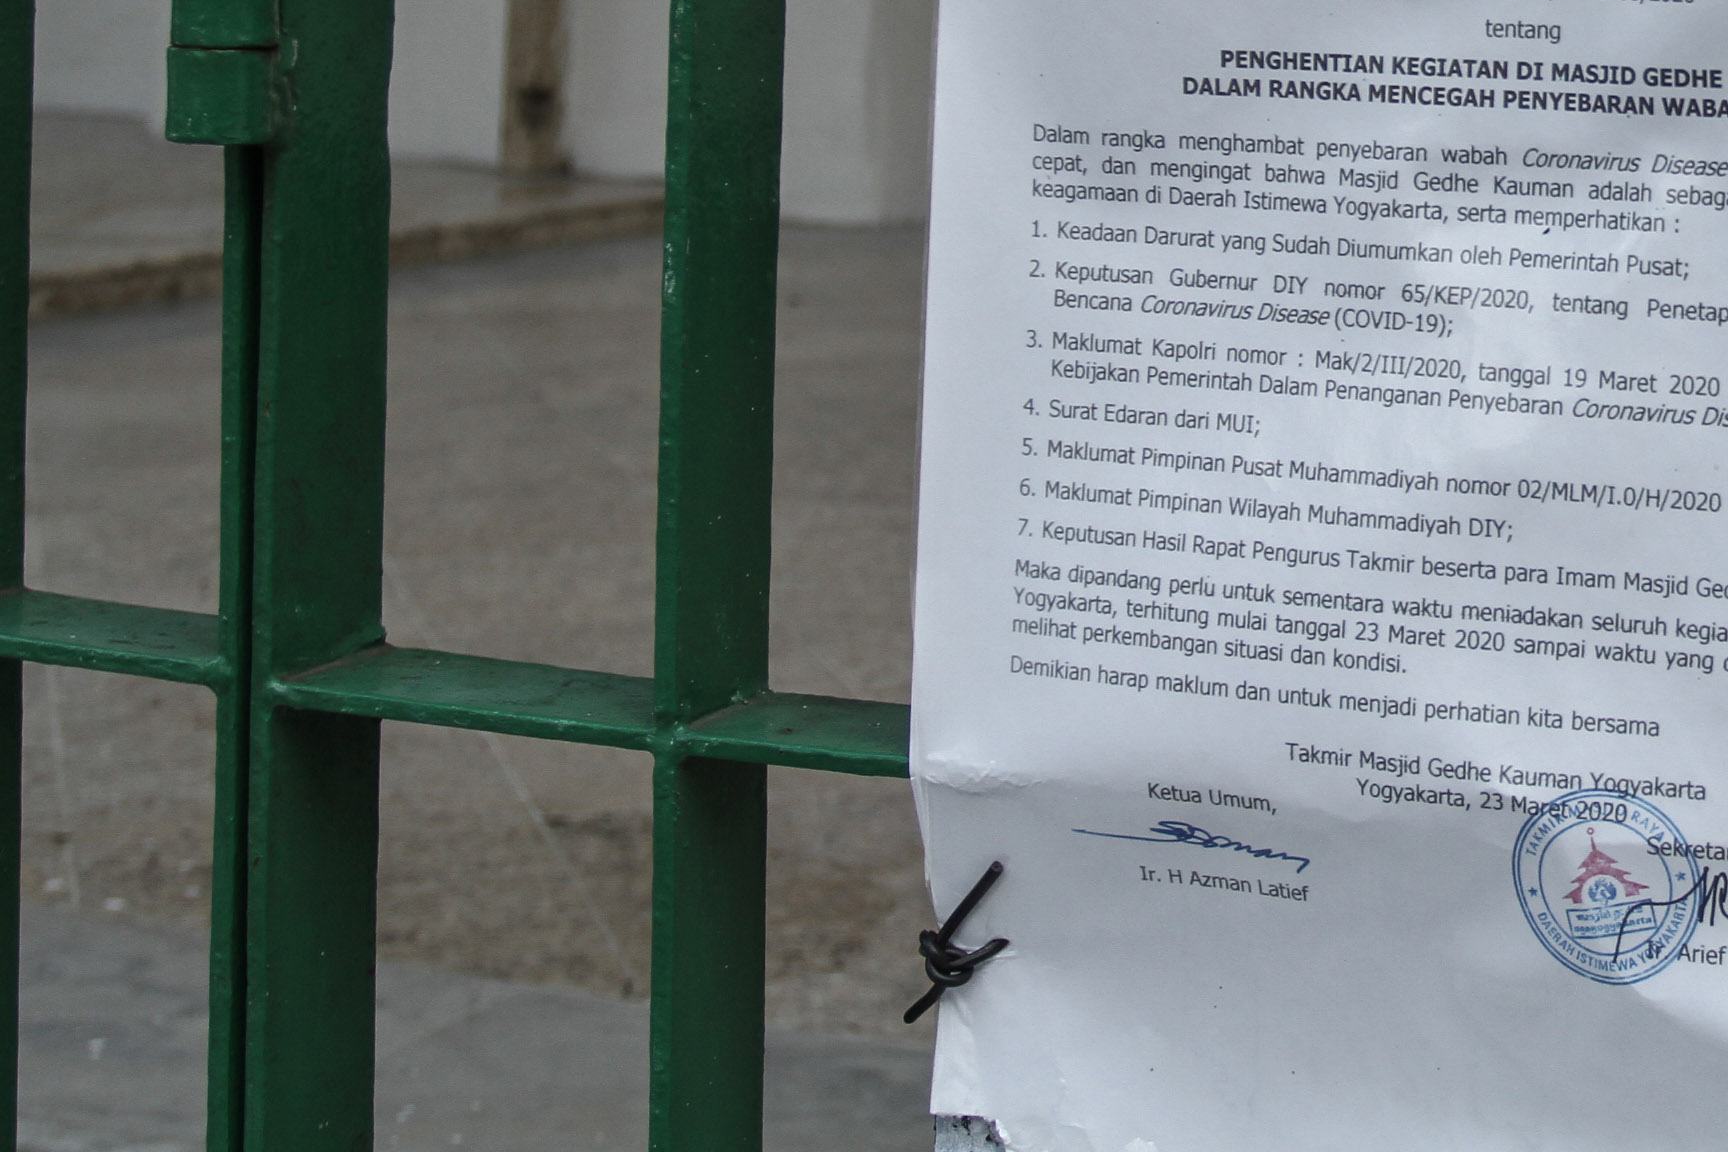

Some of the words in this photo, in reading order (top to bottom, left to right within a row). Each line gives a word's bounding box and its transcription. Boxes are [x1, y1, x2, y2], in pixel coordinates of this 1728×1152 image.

[1485, 19, 1561, 44] tentang
[1220, 50, 1384, 74] PENGHENTIAN
[1392, 56, 1508, 80] KEGIATAN
[1516, 62, 1544, 81] DI
[1552, 62, 1636, 86] MASJID
[1642, 67, 1723, 88] GEDHE
[1182, 76, 1262, 98] DALAM
[1268, 80, 1362, 102] RANGKA
[1368, 84, 1495, 108] MENCEGAH
[1502, 90, 1654, 118] PENYEBARAN
[1034, 124, 1090, 144] Dalam
[1102, 129, 1166, 152] rangka
[1179, 133, 1304, 156] menghambat
[1316, 140, 1428, 162] penyebaran
[1441, 145, 1508, 166] wabah
[1522, 148, 1642, 172] Coronavirus
[1032, 178, 1138, 204] keagamaan
[1145, 185, 1162, 204] di
[1169, 186, 1236, 208] Daerah
[1243, 190, 1327, 214] Istimewa
[1333, 196, 1448, 224] Yogyakarta,
[1457, 204, 1506, 224] serta
[1514, 209, 1666, 235] memperhatikan
[1032, 220, 1047, 238] 1.
[1058, 221, 1137, 243] Keadaan
[1144, 226, 1215, 248] Darurat
[1221, 234, 1266, 256] yang
[1272, 234, 1330, 255] Sudah
[1338, 238, 1453, 262] Diumumkan
[1460, 245, 1502, 266] oleh
[1509, 248, 1619, 272] Pemerintah
[1626, 254, 1688, 281] Pusat;
[1029, 260, 1045, 278] 2.
[1055, 261, 1153, 284] Keputusan
[1170, 268, 1258, 291] Gubernur
[1272, 274, 1308, 294] DIY
[1324, 282, 1386, 300] nomor
[1552, 293, 1628, 320] tentang
[1049, 399, 1098, 421] Surat
[1104, 404, 1168, 426] Edaran
[1174, 409, 1210, 430] dari
[1216, 413, 1260, 438] MUI;
[1045, 480, 1132, 506] Maklumat
[1138, 488, 1222, 514] Pimpinan
[1228, 496, 1300, 524] Wilayah
[1308, 504, 1460, 538] Muhammadiyah
[1469, 518, 1512, 543] DIY;
[1015, 559, 1061, 581] Maka
[1068, 564, 1162, 596] dipandang
[1168, 576, 1216, 598] perlu
[1222, 583, 1276, 604] untuk
[1282, 590, 1384, 614] sementara
[1392, 598, 1452, 619] waktu
[1460, 604, 1584, 629] meniadakan
[1592, 612, 1668, 636] seluruh
[1010, 655, 1091, 682] Demikian
[1098, 664, 1149, 692] harap
[1156, 674, 1228, 698] maklum
[1236, 680, 1270, 702] dan
[1278, 688, 1332, 708] untuk
[1339, 695, 1416, 718] menjadi
[1424, 700, 1520, 725] perhatian
[1528, 706, 1563, 729] kita
[1572, 710, 1660, 737] bersama
[1284, 742, 1352, 766] Takmir
[1360, 750, 1420, 778] Masjid
[1428, 758, 1492, 782] Gedhe
[1499, 765, 1582, 791] Kauman
[1590, 772, 1706, 801] Yogyakarta
[1148, 782, 1202, 804] Ketua
[1208, 789, 1276, 816] Umum,
[1356, 778, 1471, 811] Yogyakarta,
[1479, 791, 1504, 811] 23
[1511, 796, 1569, 820] Maret
[1576, 801, 1628, 823] 2020
[1140, 866, 1161, 882] Ir.
[1168, 869, 1182, 884] H
[1190, 871, 1252, 893] Azman
[1257, 880, 1308, 902] Latief
[1677, 943, 1727, 966] Arief
